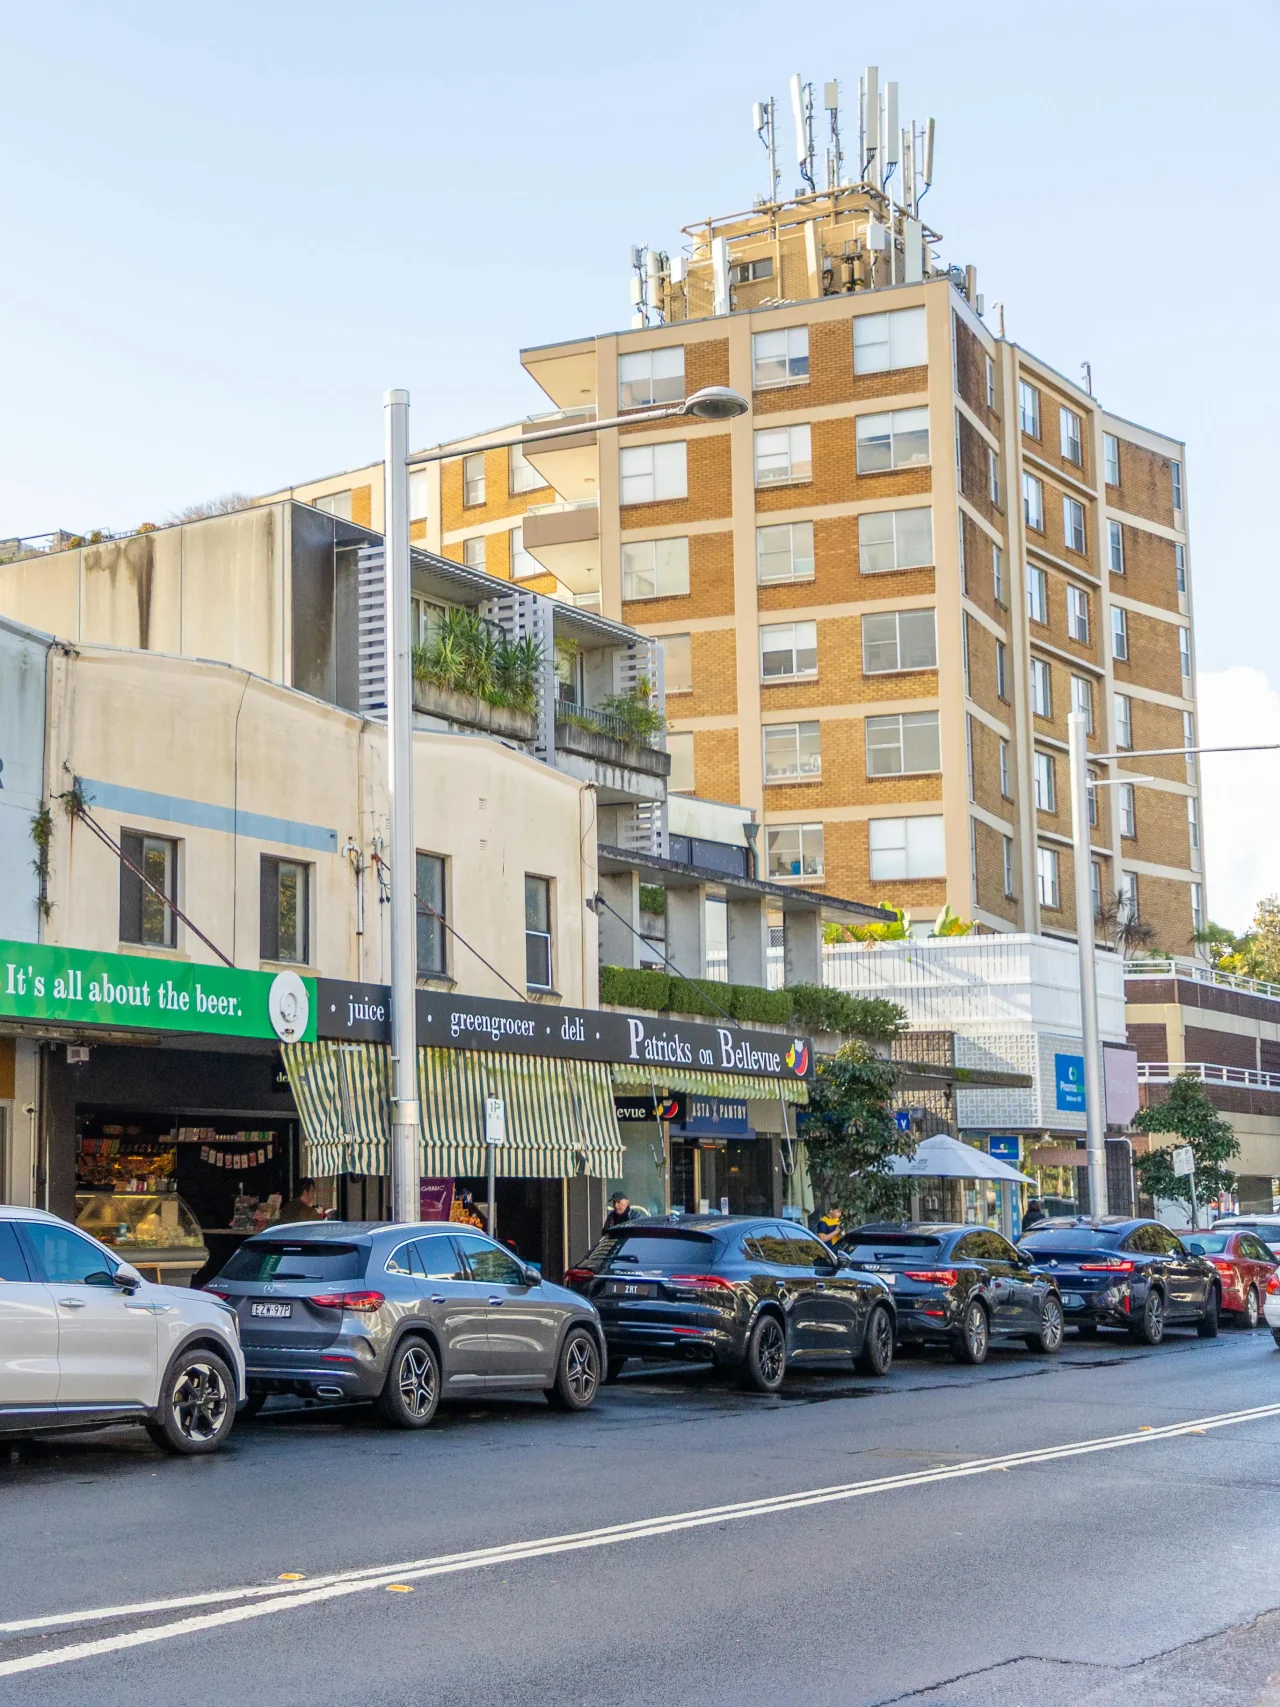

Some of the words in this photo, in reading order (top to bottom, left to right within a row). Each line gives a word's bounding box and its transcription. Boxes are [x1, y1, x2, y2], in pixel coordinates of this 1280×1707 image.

[5, 963, 45, 997] It's
[54, 969, 82, 1000] all
[89, 973, 151, 1008] about
[158, 980, 189, 1011] the
[196, 984, 242, 1017] beer.
[347, 994, 385, 1026] juice
[450, 1011, 535, 1041] greengrocer
[561, 1016, 585, 1041] deli
[627, 1018, 692, 1063] Patricks
[699, 1048, 714, 1065] on
[717, 1029, 781, 1072] Bellevue
[276, 1072, 287, 1082] de
[616, 1108, 646, 1118] evue
[692, 1102, 709, 1117] ASTA
[720, 1104, 746, 1119] PANTRY
